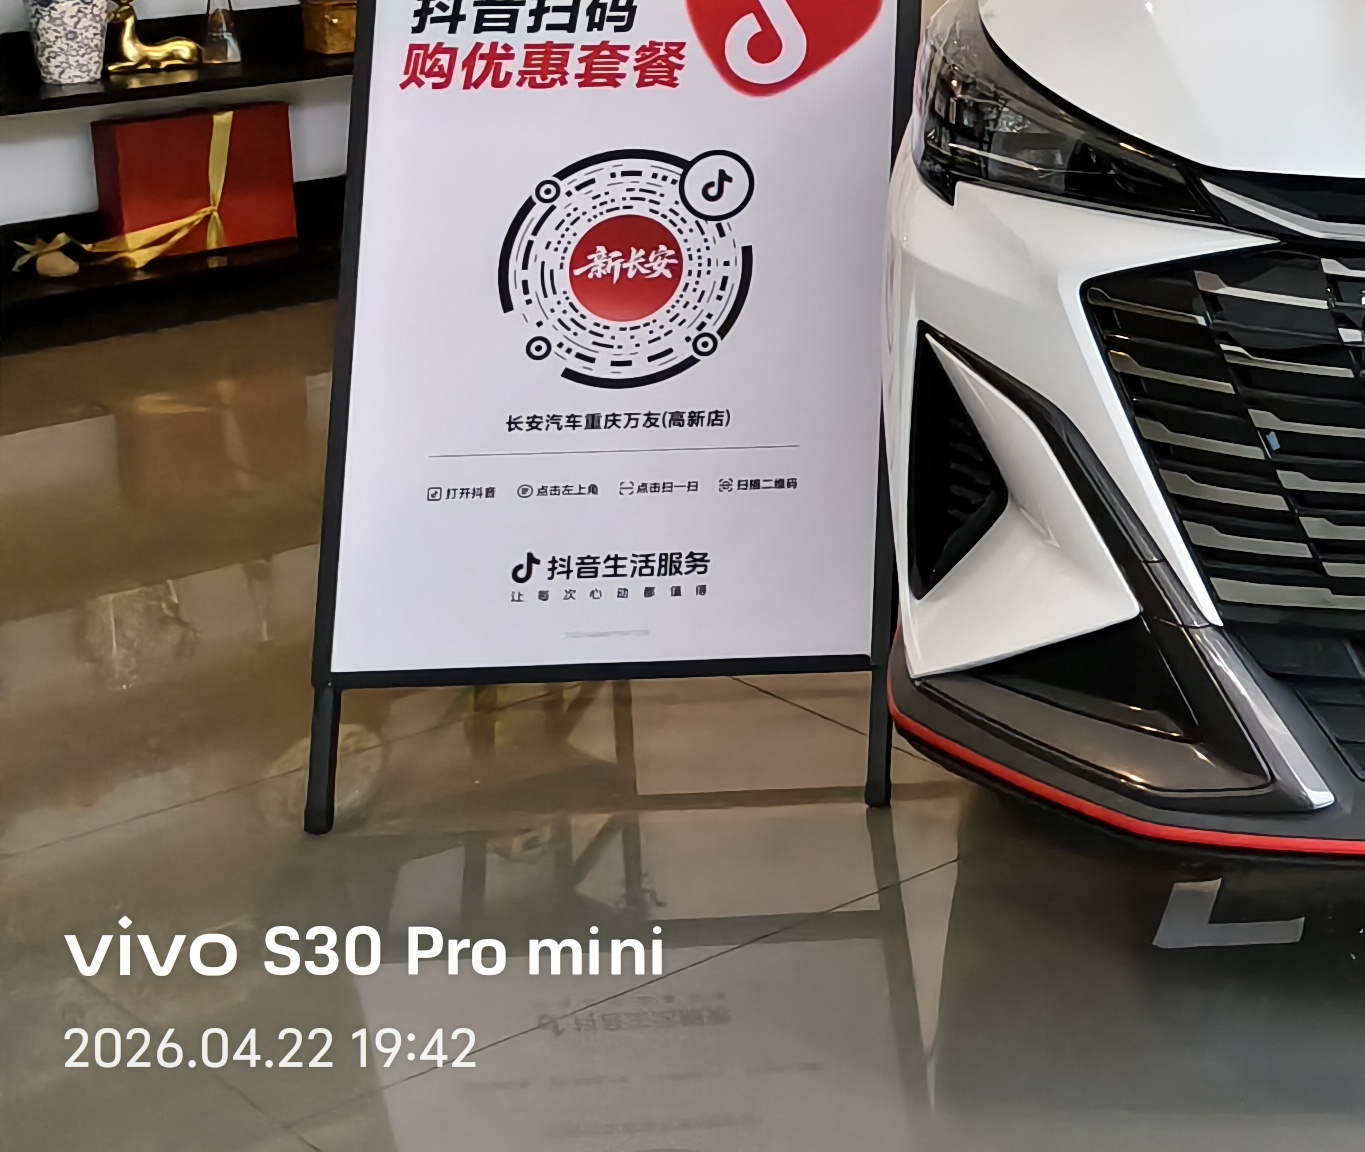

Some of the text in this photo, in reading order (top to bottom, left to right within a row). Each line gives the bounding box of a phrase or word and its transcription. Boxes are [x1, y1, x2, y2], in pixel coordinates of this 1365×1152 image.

[399, 39, 688, 92] 购优惠套餐
[573, 245, 679, 285] 新长安
[505, 408, 732, 433] 长安汽车重庆万友(高新店)
[445, 486, 496, 500] 打开抖音
[536, 483, 599, 497] 点击左上角
[636, 480, 699, 494] 点击扫一扫
[546, 551, 711, 581] 抖音生活服务
